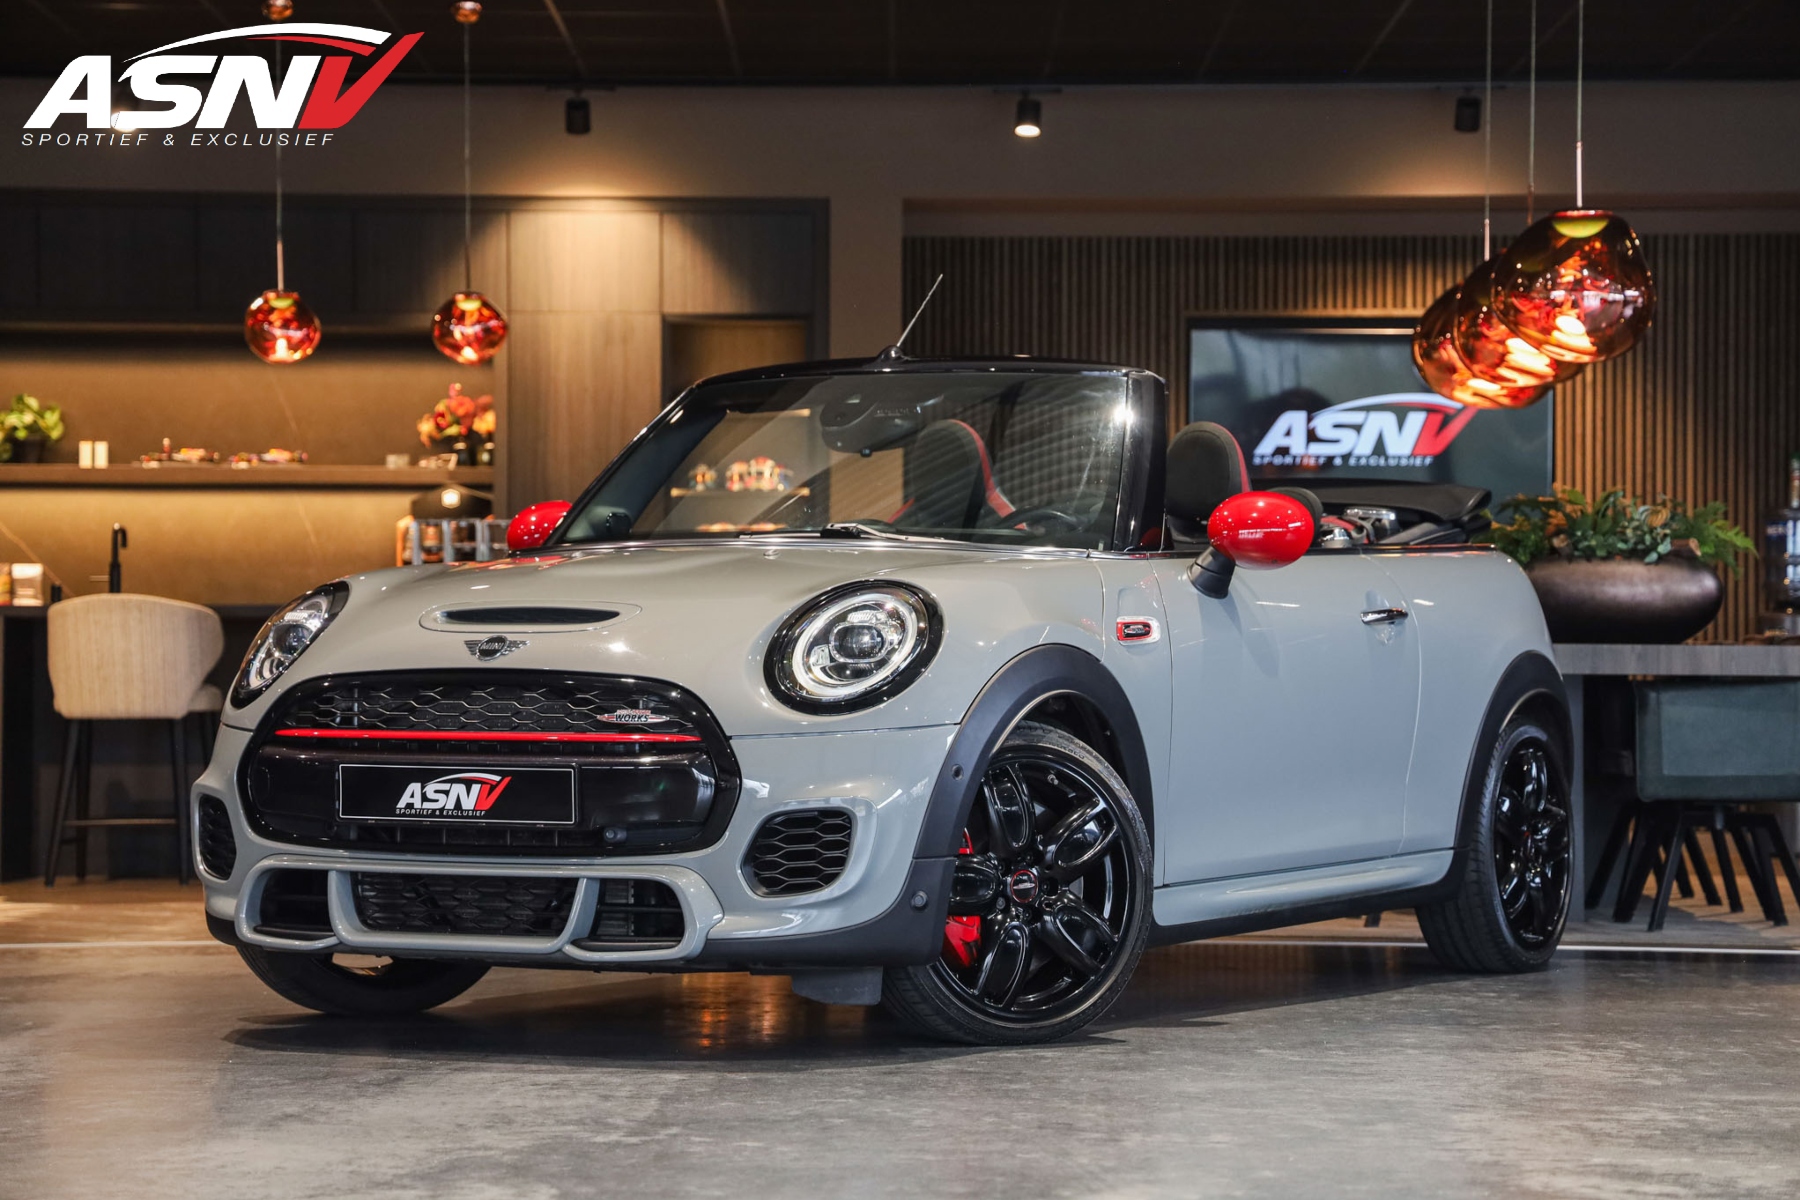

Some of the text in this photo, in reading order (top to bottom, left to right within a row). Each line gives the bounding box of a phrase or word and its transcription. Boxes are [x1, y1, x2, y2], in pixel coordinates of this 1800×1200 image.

[1252, 406, 1480, 456] ASNV
[480, 642, 505, 650] MINI
[615, 714, 649, 722] WORKS
[396, 776, 512, 811] ASNV
